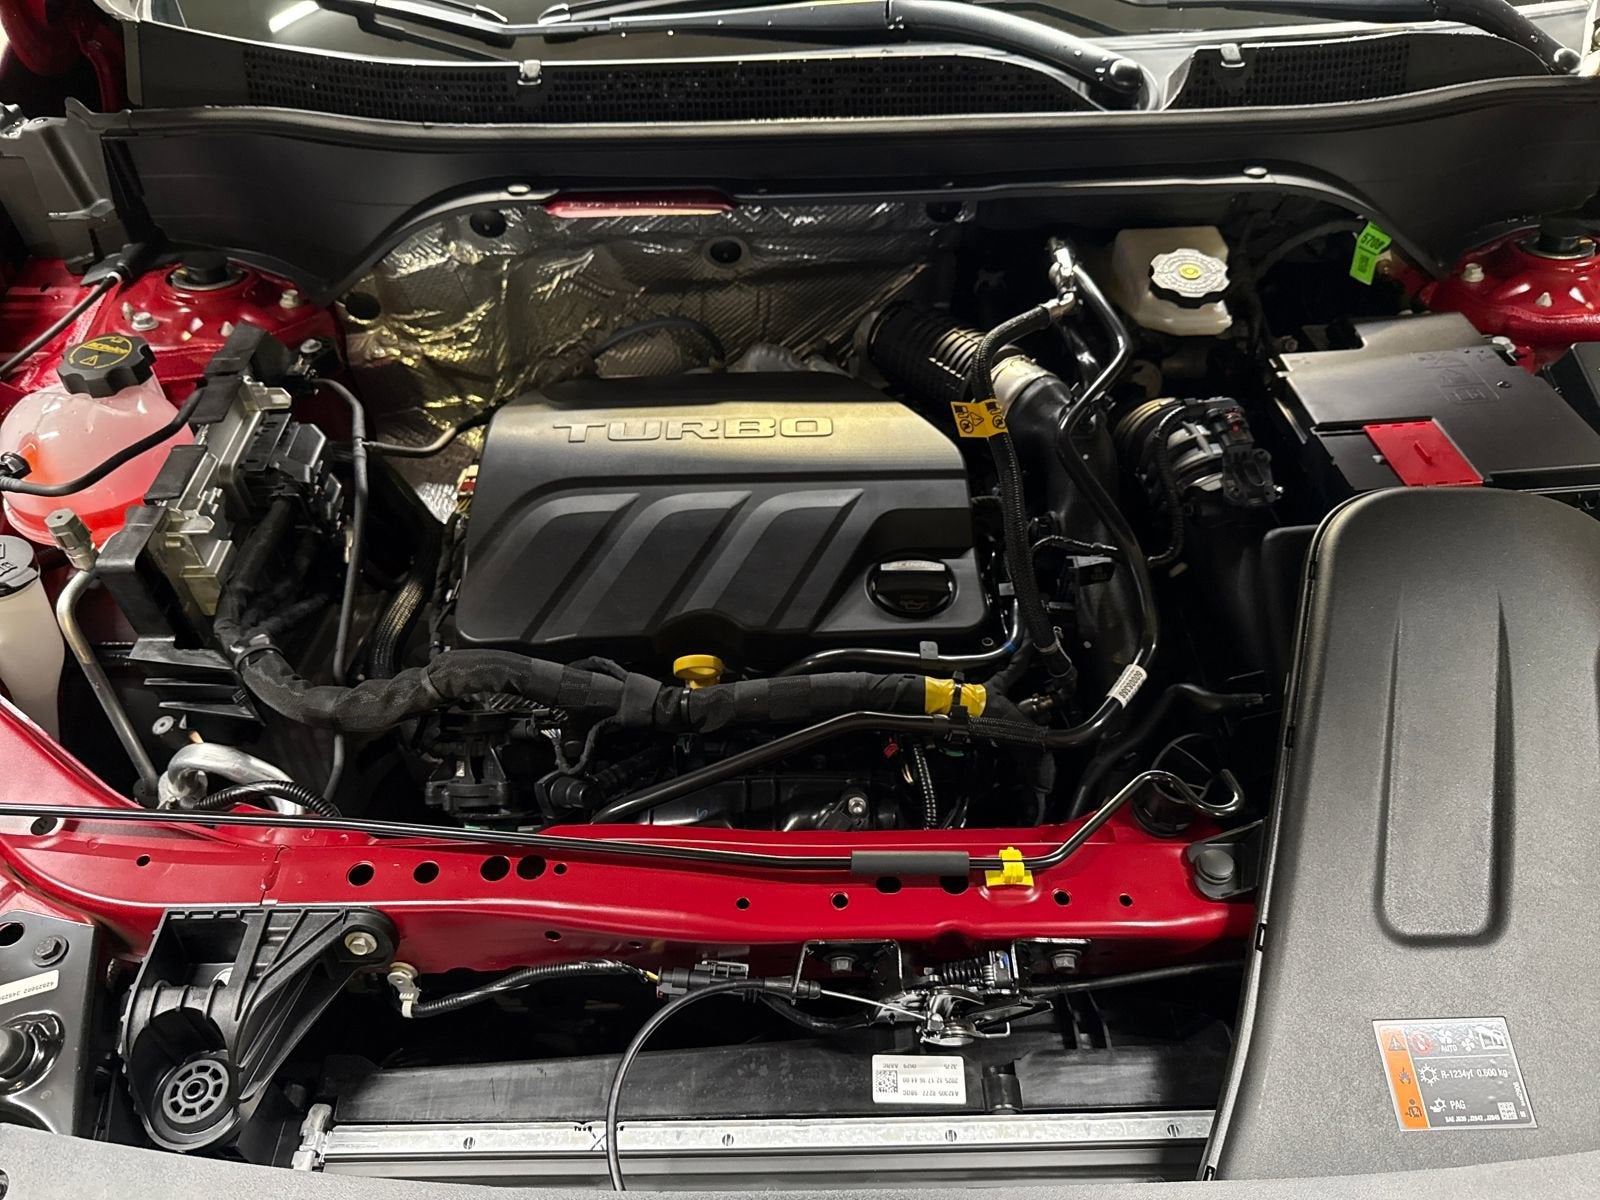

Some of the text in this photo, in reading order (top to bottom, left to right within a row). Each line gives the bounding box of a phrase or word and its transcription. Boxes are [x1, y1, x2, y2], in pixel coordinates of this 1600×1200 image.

[553, 417, 834, 443] TURBO
[1440, 1044, 1458, 1052] AUTO
[1450, 1099, 1466, 1110] PAG
